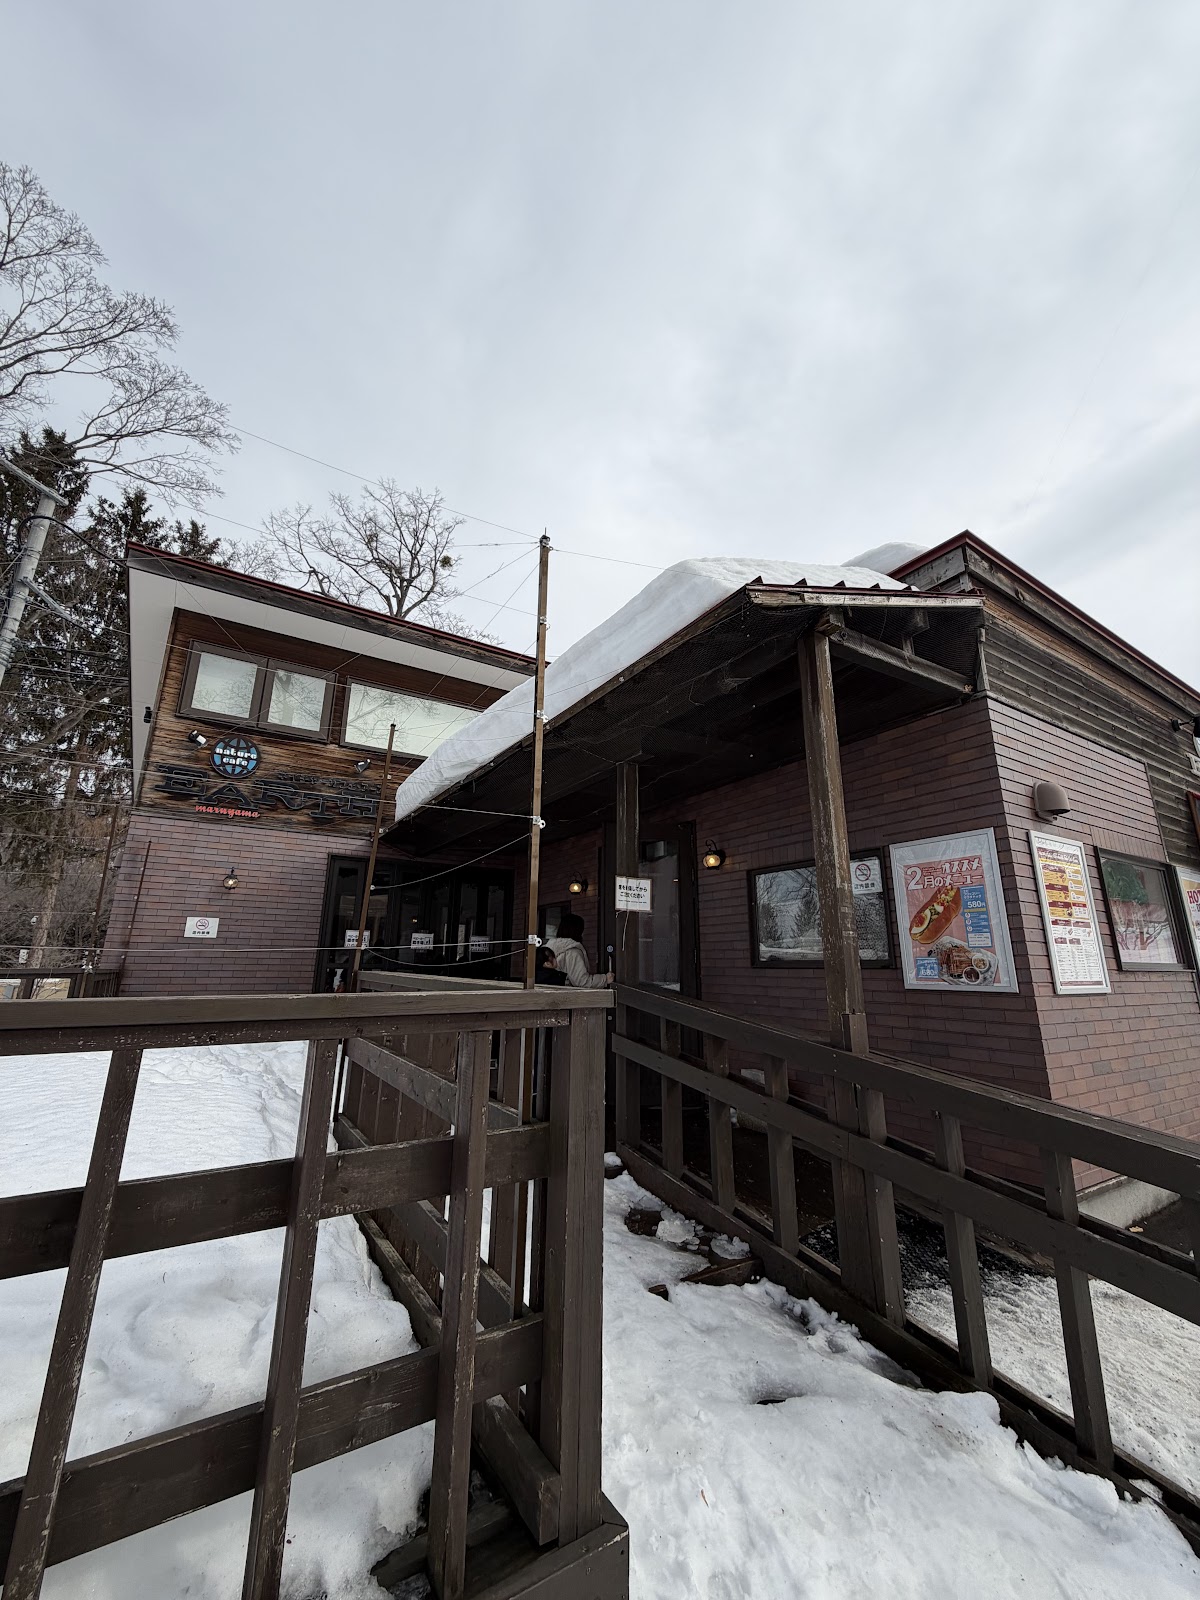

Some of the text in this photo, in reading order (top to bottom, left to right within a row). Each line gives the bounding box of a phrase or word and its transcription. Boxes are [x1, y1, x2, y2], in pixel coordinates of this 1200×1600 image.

[215, 748, 257, 760] nature
[222, 757, 248, 767] cafe
[155, 764, 380, 818] EARTH
[195, 804, 260, 819] maruyama
[942, 858, 982, 874] オススメ
